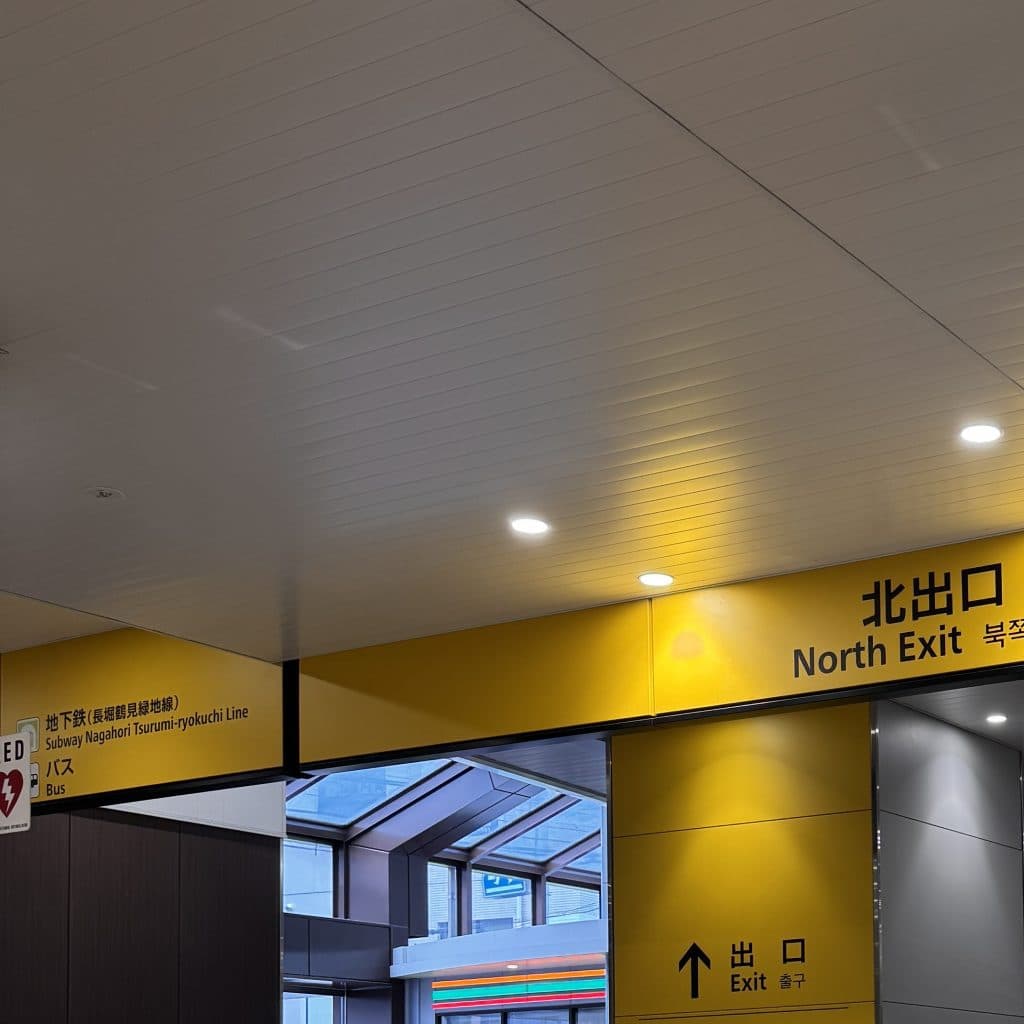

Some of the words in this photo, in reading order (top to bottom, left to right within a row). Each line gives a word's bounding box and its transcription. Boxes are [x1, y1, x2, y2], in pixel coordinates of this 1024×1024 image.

[861, 562, 1004, 628] 北出口
[793, 635, 887, 679] North
[899, 625, 963, 663] Exit
[46, 733, 83, 751] Subway
[85, 722, 131, 745] Nagahori
[133, 707, 223, 736] Tsurumi-ryokuchi
[226, 705, 249, 720] Line
[0, 740, 24, 763] ED
[46, 758, 75, 778] バス
[47, 784, 66, 797] Bus
[730, 938, 806, 969] 出口
[730, 972, 767, 992] Exit
[778, 973, 806, 990] 출구
